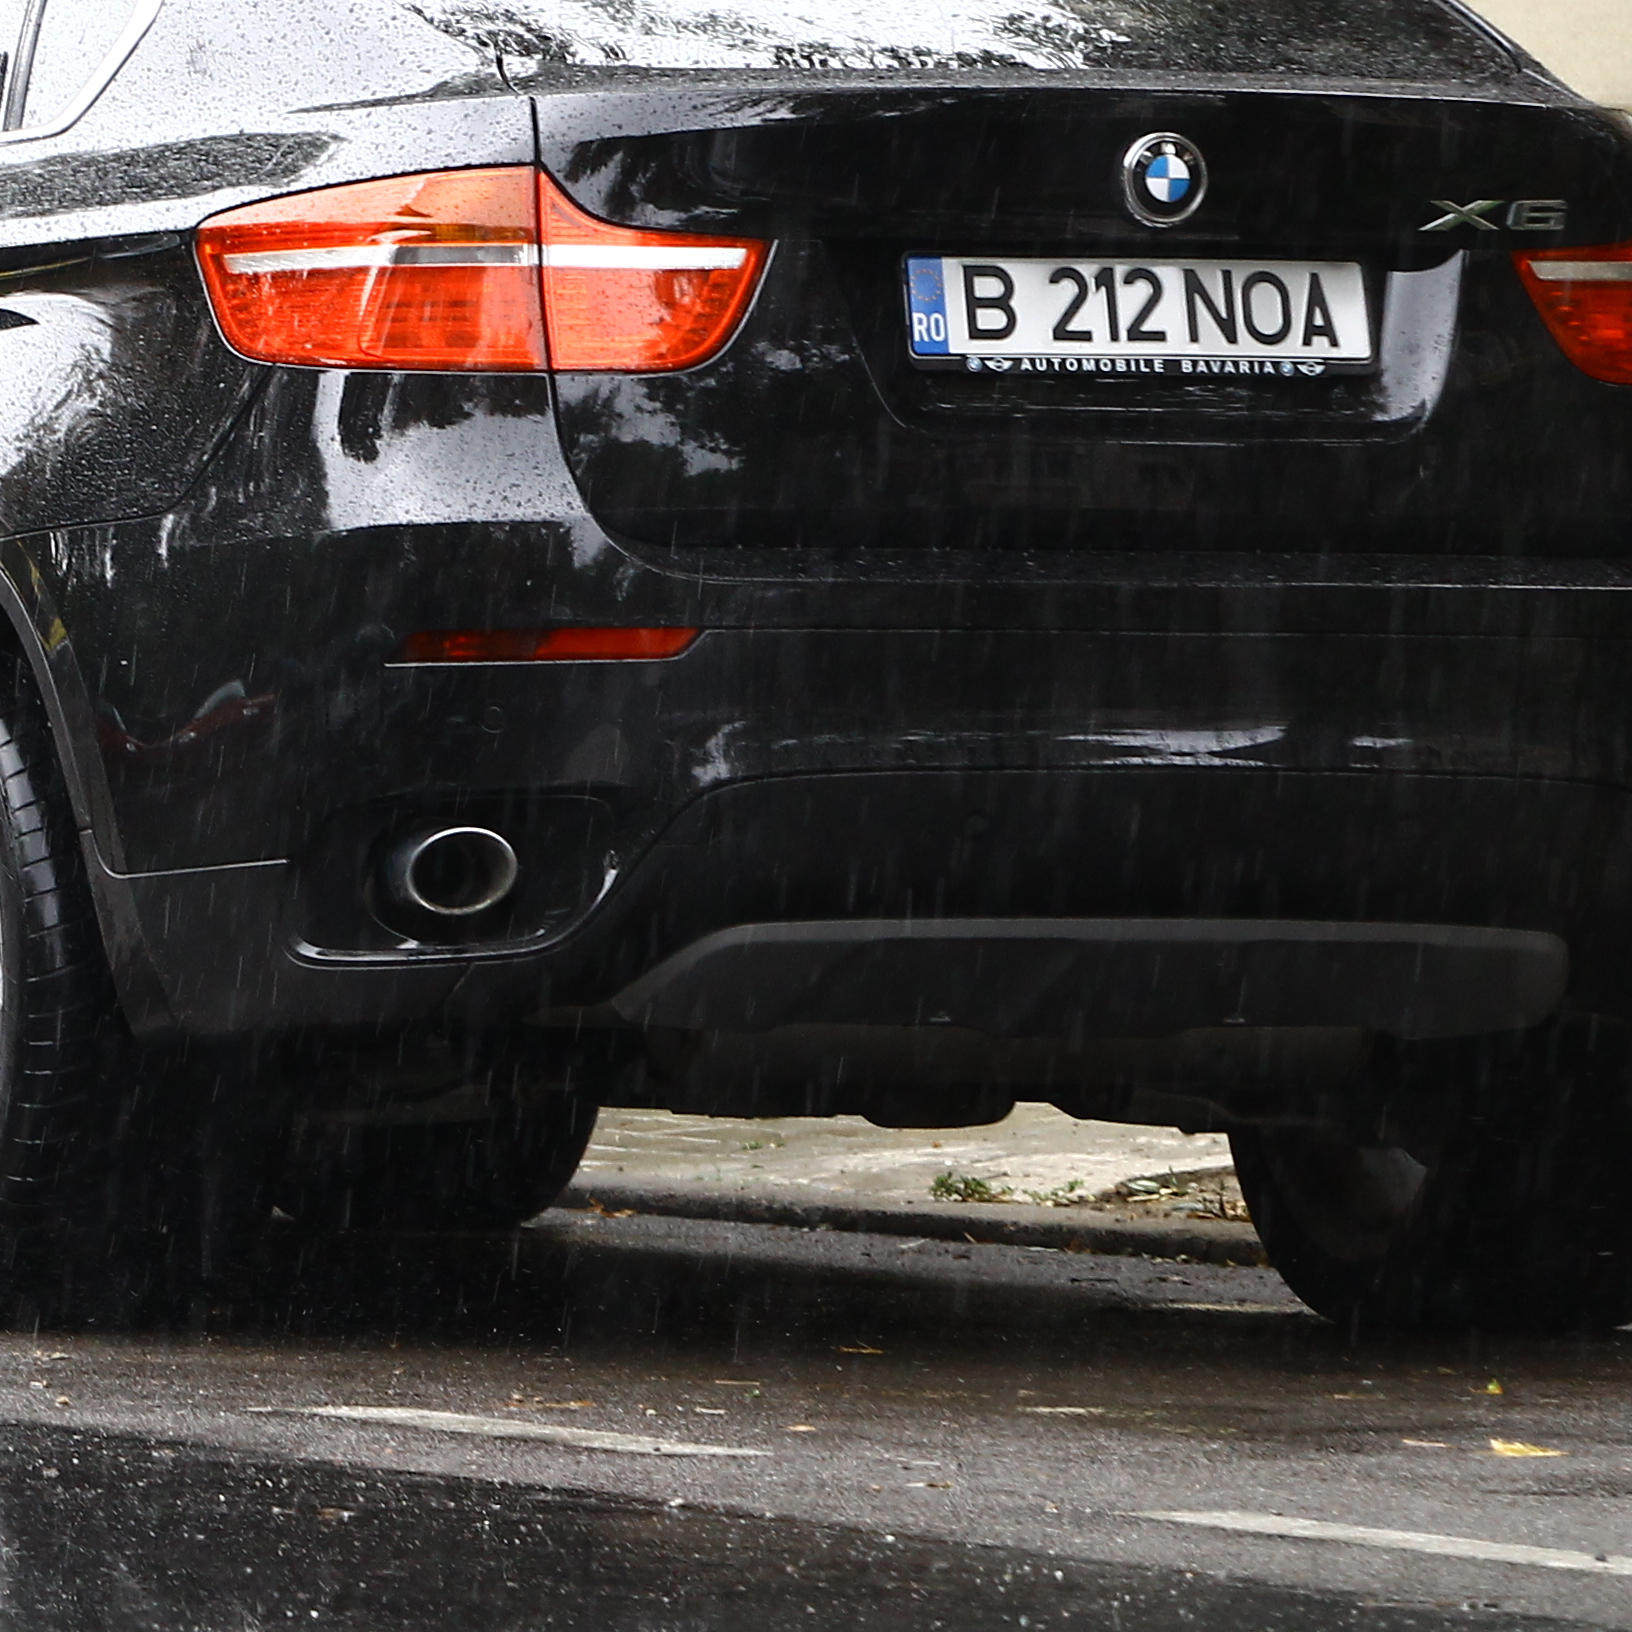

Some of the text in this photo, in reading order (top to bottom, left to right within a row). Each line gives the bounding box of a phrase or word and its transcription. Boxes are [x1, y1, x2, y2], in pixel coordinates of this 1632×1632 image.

[1418, 199, 1568, 231] X6
[912, 264, 1340, 348] RO B 212 NOA
[1019, 357, 1276, 376] AUTOMOBILE BAVARIA
